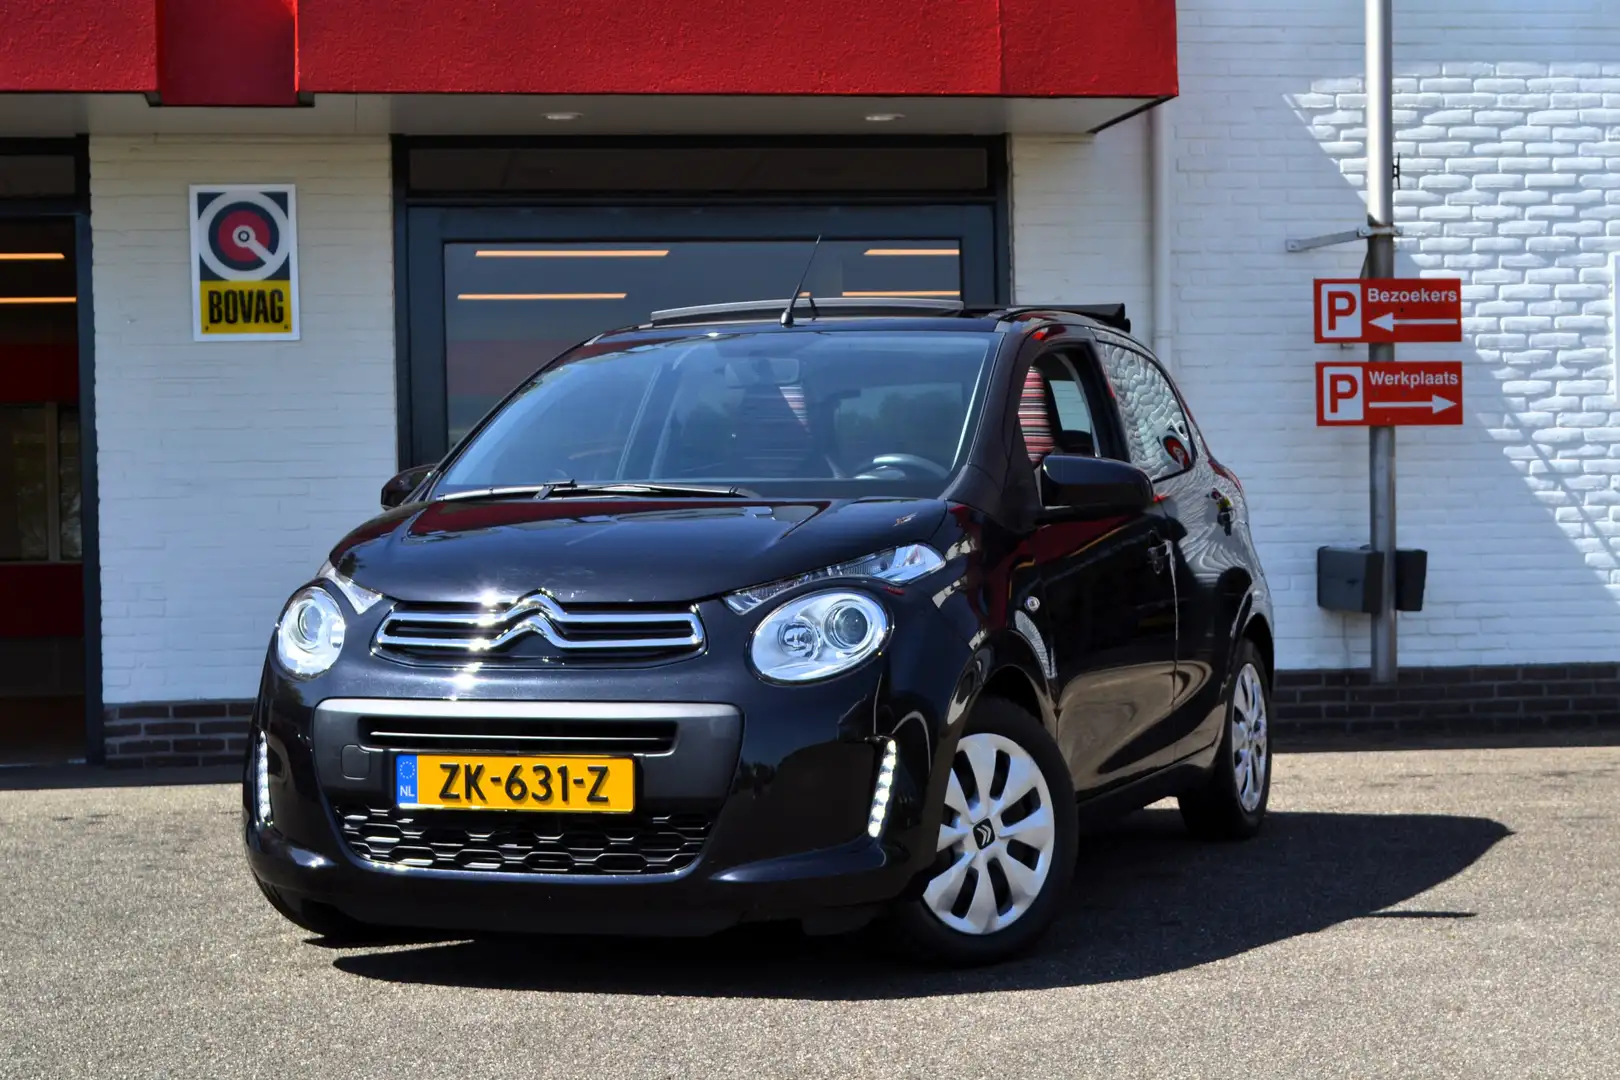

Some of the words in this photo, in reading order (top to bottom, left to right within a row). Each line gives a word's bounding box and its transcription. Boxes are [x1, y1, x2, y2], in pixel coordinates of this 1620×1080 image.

[208, 289, 284, 324] BOVAG
[1328, 291, 1357, 330] P
[1367, 288, 1457, 302] Bezoekers
[1329, 374, 1359, 413] P
[1369, 370, 1459, 388] Werkplaats
[400, 785, 415, 797] NL
[438, 763, 610, 804] ZK-631-Z
